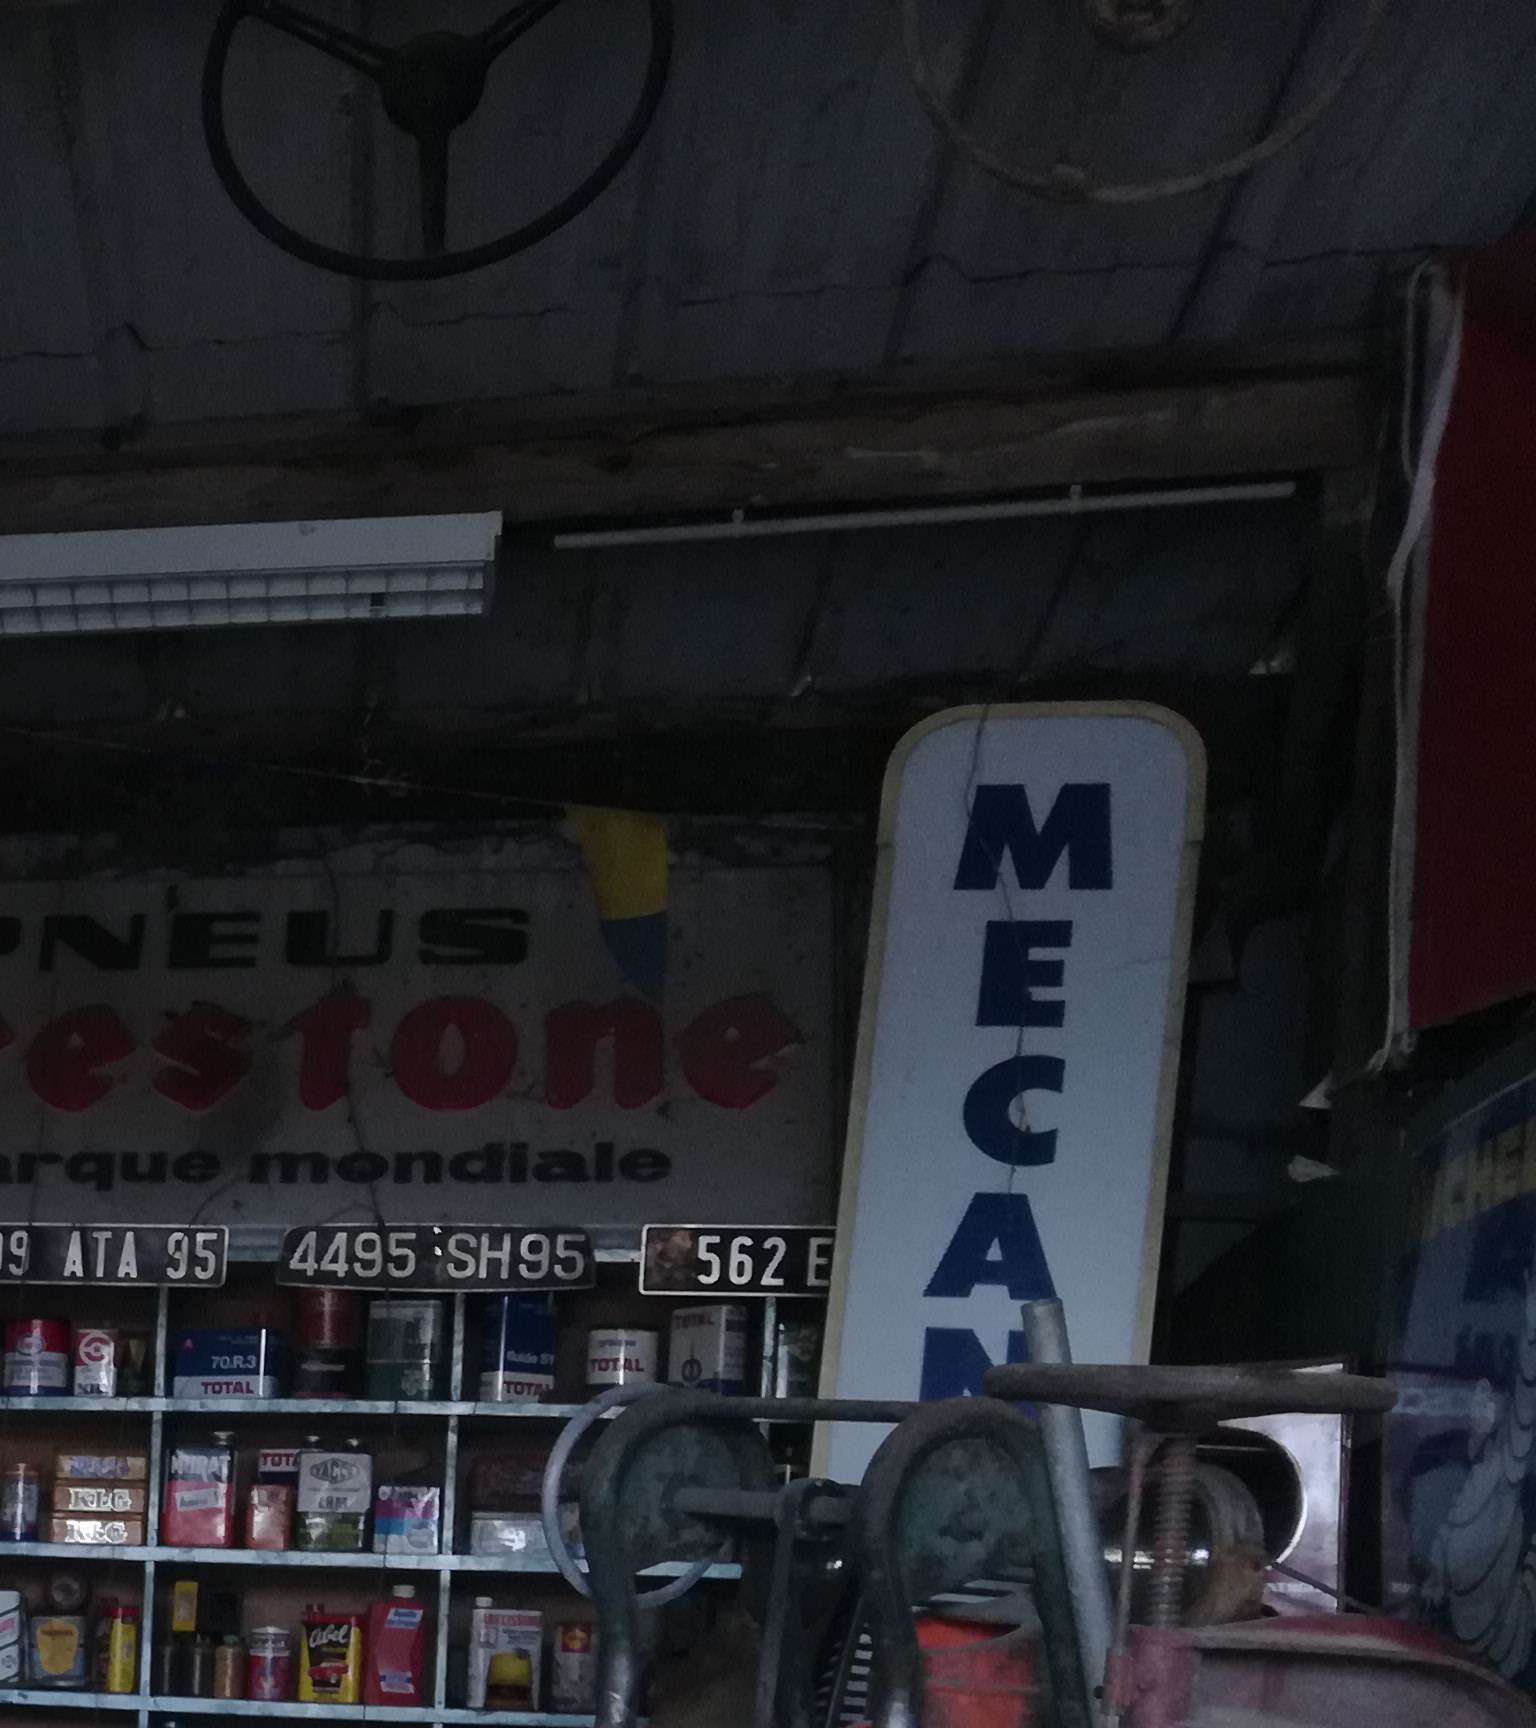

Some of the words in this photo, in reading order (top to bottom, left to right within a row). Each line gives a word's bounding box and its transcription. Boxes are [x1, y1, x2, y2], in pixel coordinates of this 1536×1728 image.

[248, 1140, 673, 1187] mondiale
[62, 1230, 138, 1279] ATA
[165, 1231, 219, 1280] 95
[288, 1230, 417, 1279] 4495
[696, 1234, 788, 1287] 562
[200, 1381, 256, 1395] TOTAL
[591, 1357, 645, 1373] TOTAL
[260, 1453, 300, 1467] TOTA
